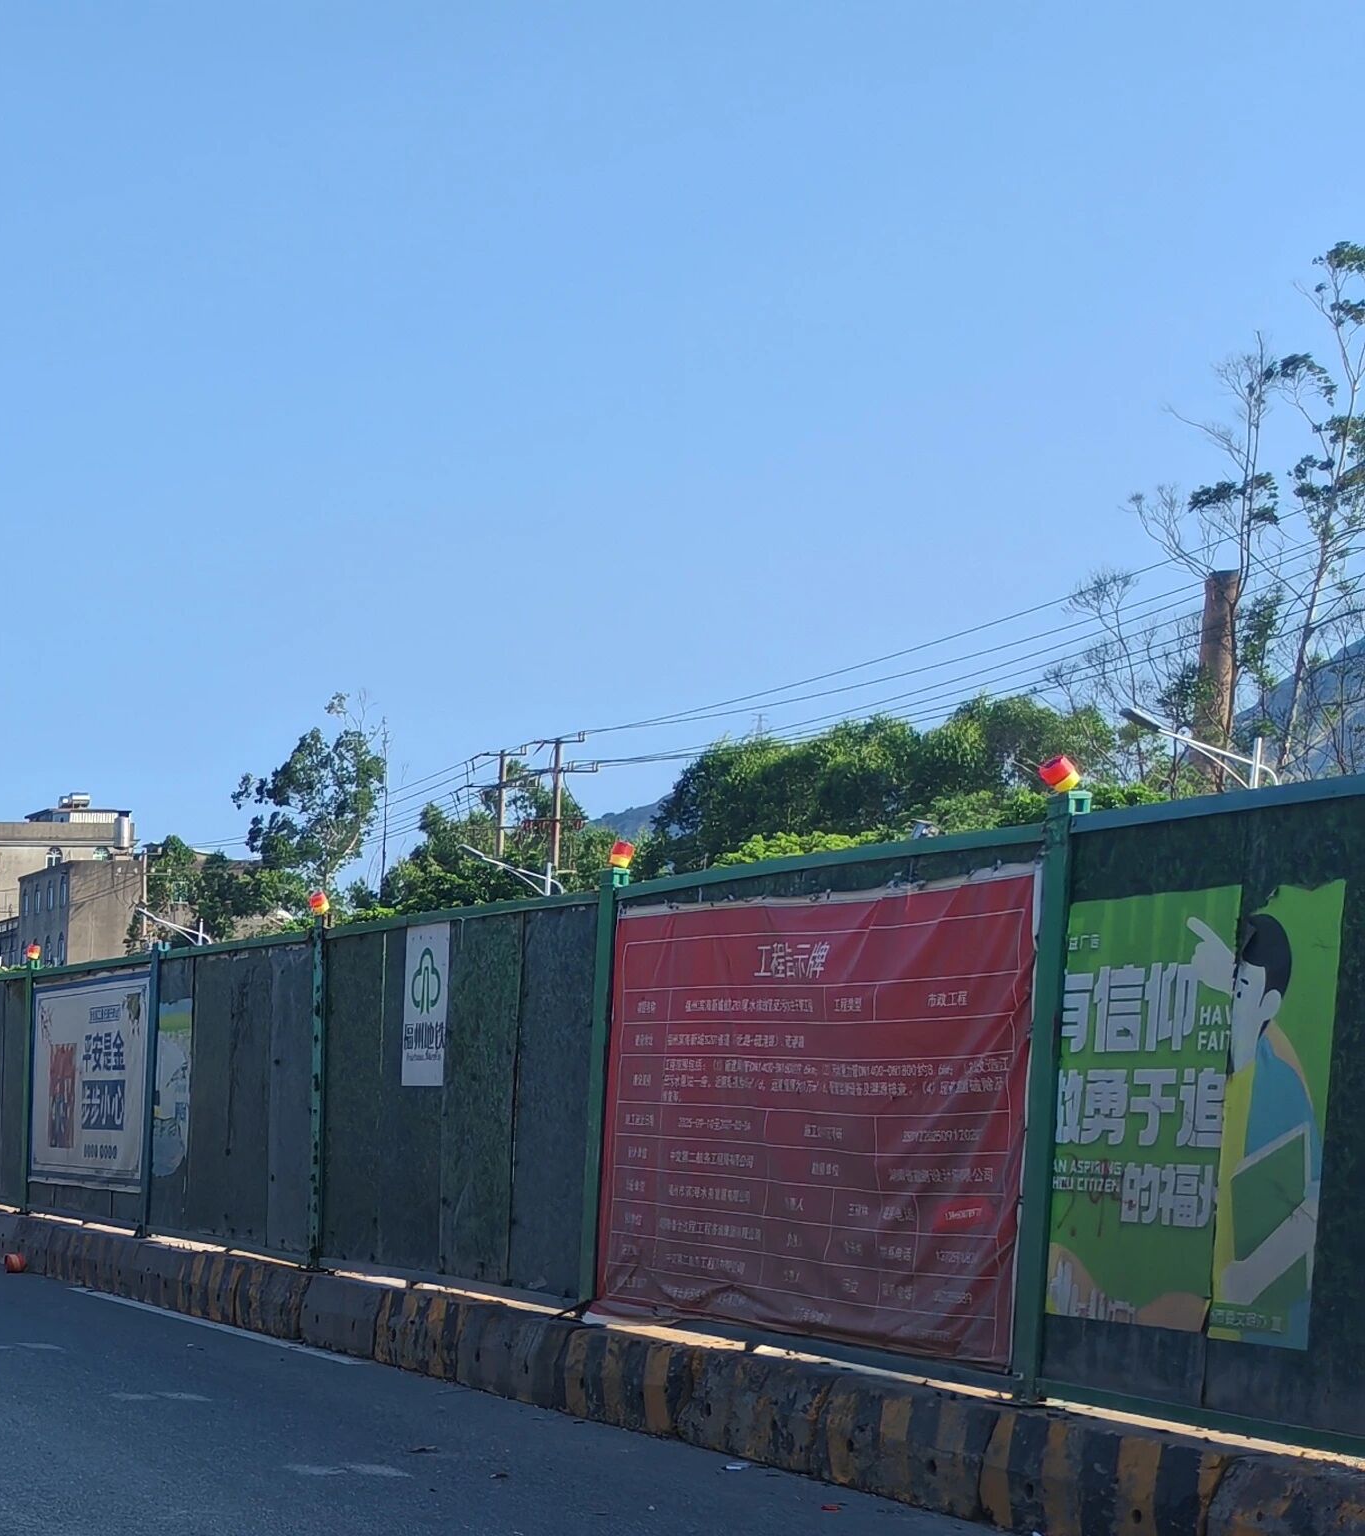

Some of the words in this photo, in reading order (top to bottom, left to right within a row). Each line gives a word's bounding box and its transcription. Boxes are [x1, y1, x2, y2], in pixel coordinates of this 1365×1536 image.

[753, 941, 830, 980] 工程告示牌
[928, 991, 968, 1008] 市政工程
[82, 1030, 125, 1072] 平安是金
[404, 1022, 447, 1050] 福州地铁
[81, 1085, 124, 1126] 步步小心
